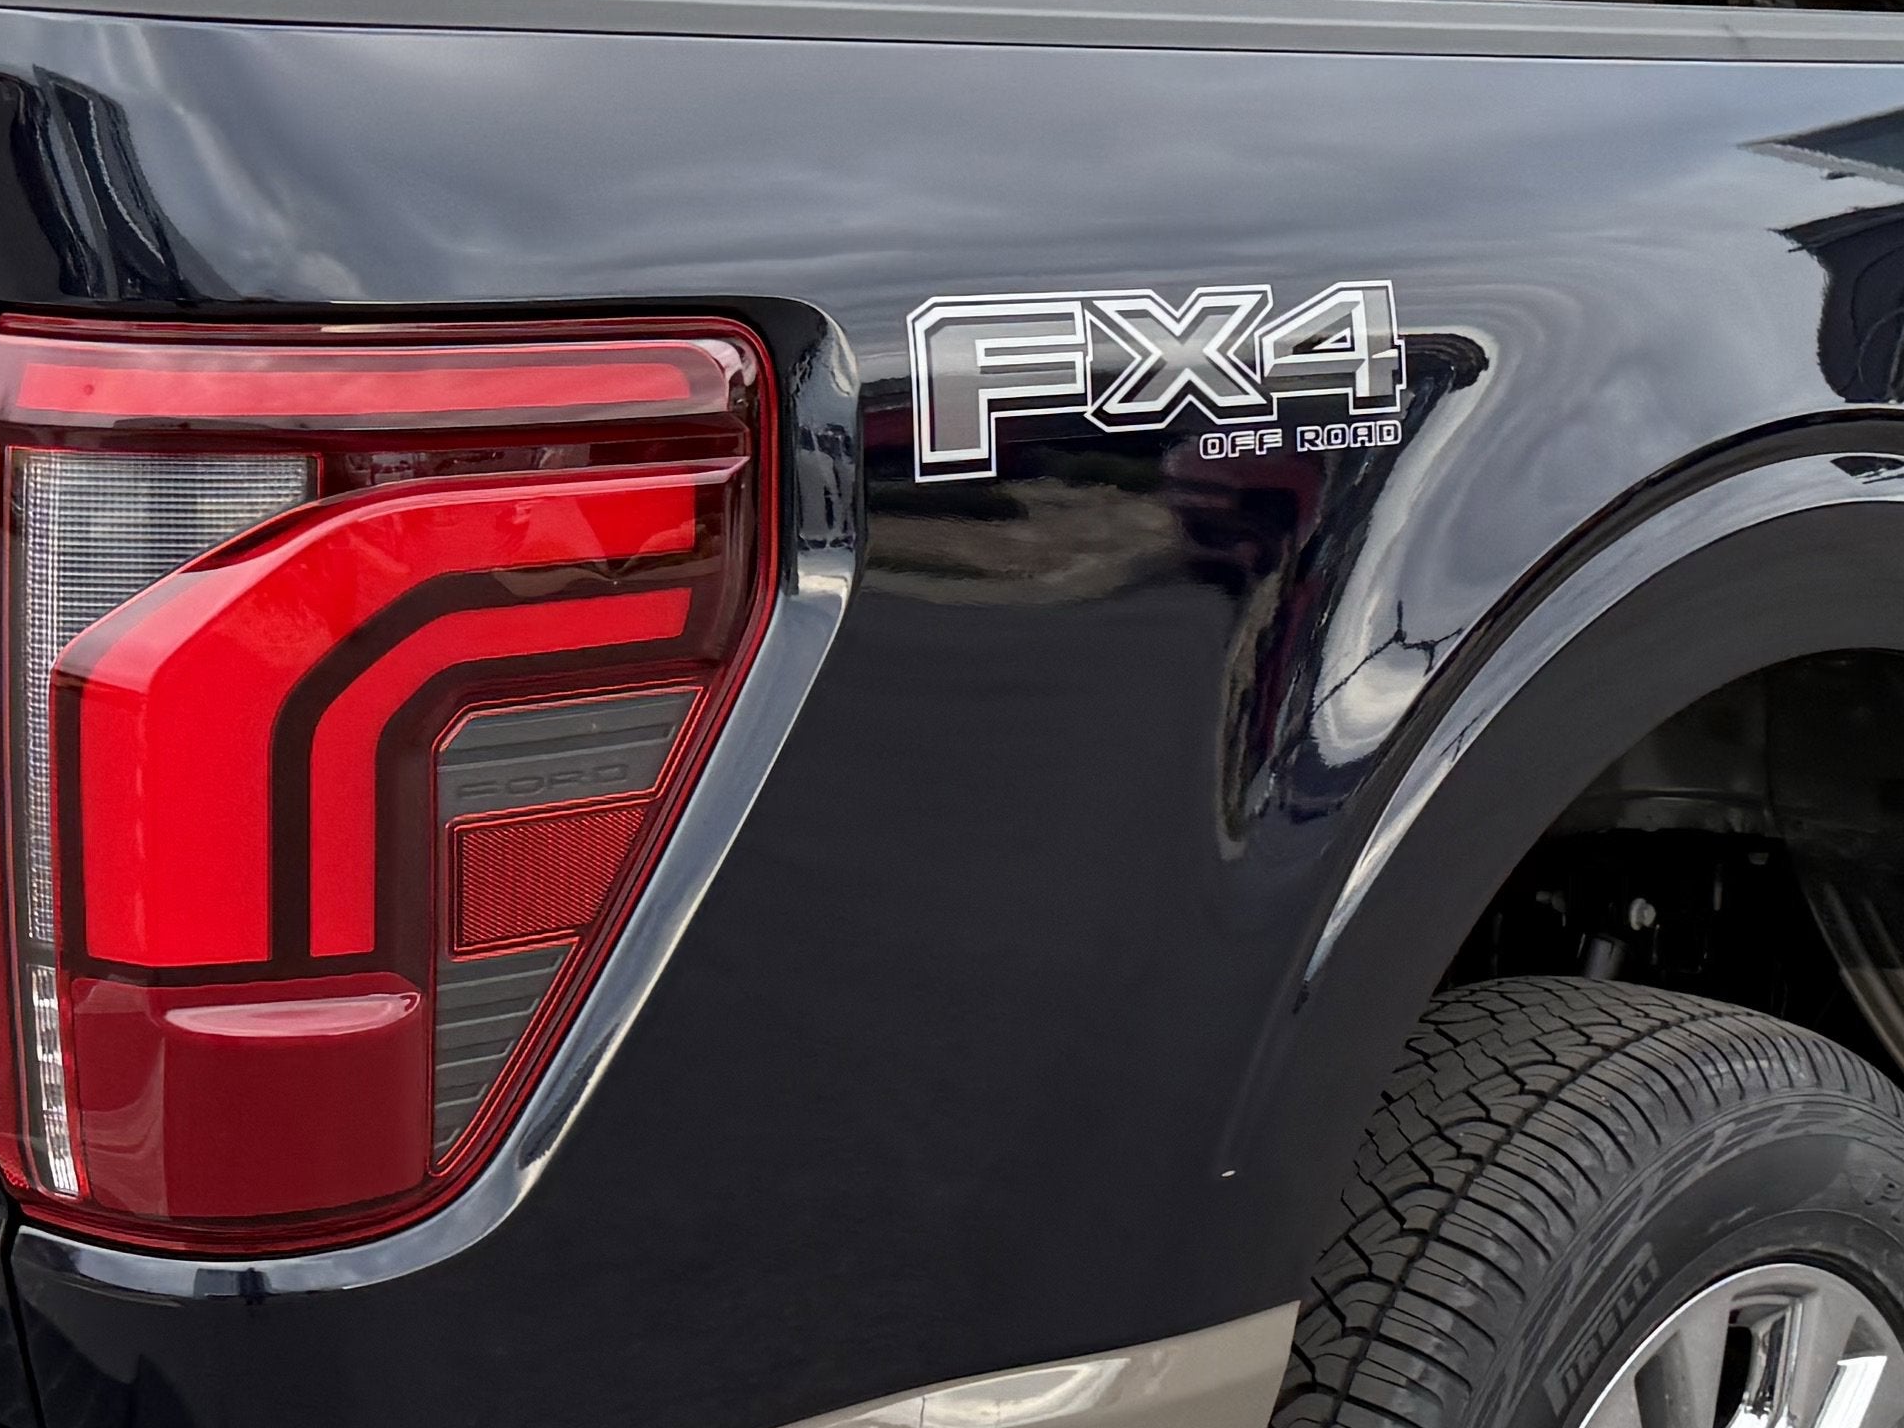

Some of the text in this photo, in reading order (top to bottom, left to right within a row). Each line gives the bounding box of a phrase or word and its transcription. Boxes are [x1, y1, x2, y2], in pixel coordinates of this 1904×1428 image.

[906, 280, 1406, 482] FX4
[1199, 419, 1403, 460] OFF ROAD
[456, 763, 629, 799] FORD
